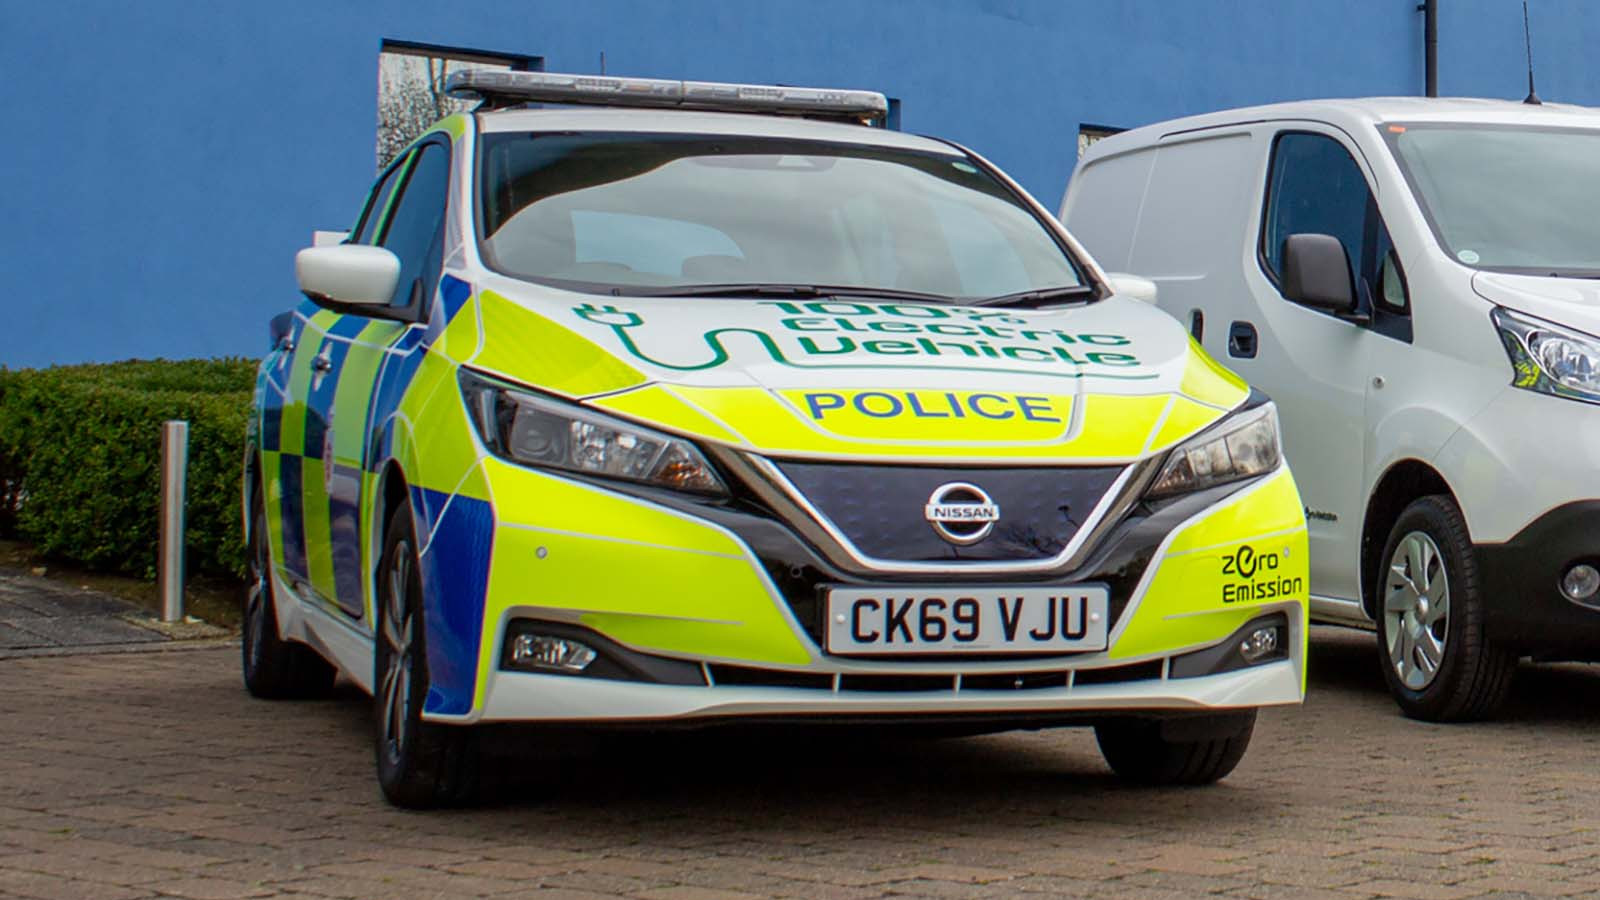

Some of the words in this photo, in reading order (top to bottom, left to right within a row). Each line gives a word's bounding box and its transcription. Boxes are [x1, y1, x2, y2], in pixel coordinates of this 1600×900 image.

[757, 302, 1027, 324] 100%
[781, 318, 1132, 346] Electric
[797, 331, 1141, 366] Vehicle
[804, 392, 1062, 423] POLICE
[934, 507, 993, 518] NISSAN
[1223, 576, 1302, 603] Emission
[852, 598, 980, 643] CK69
[998, 597, 1089, 641] VJU
